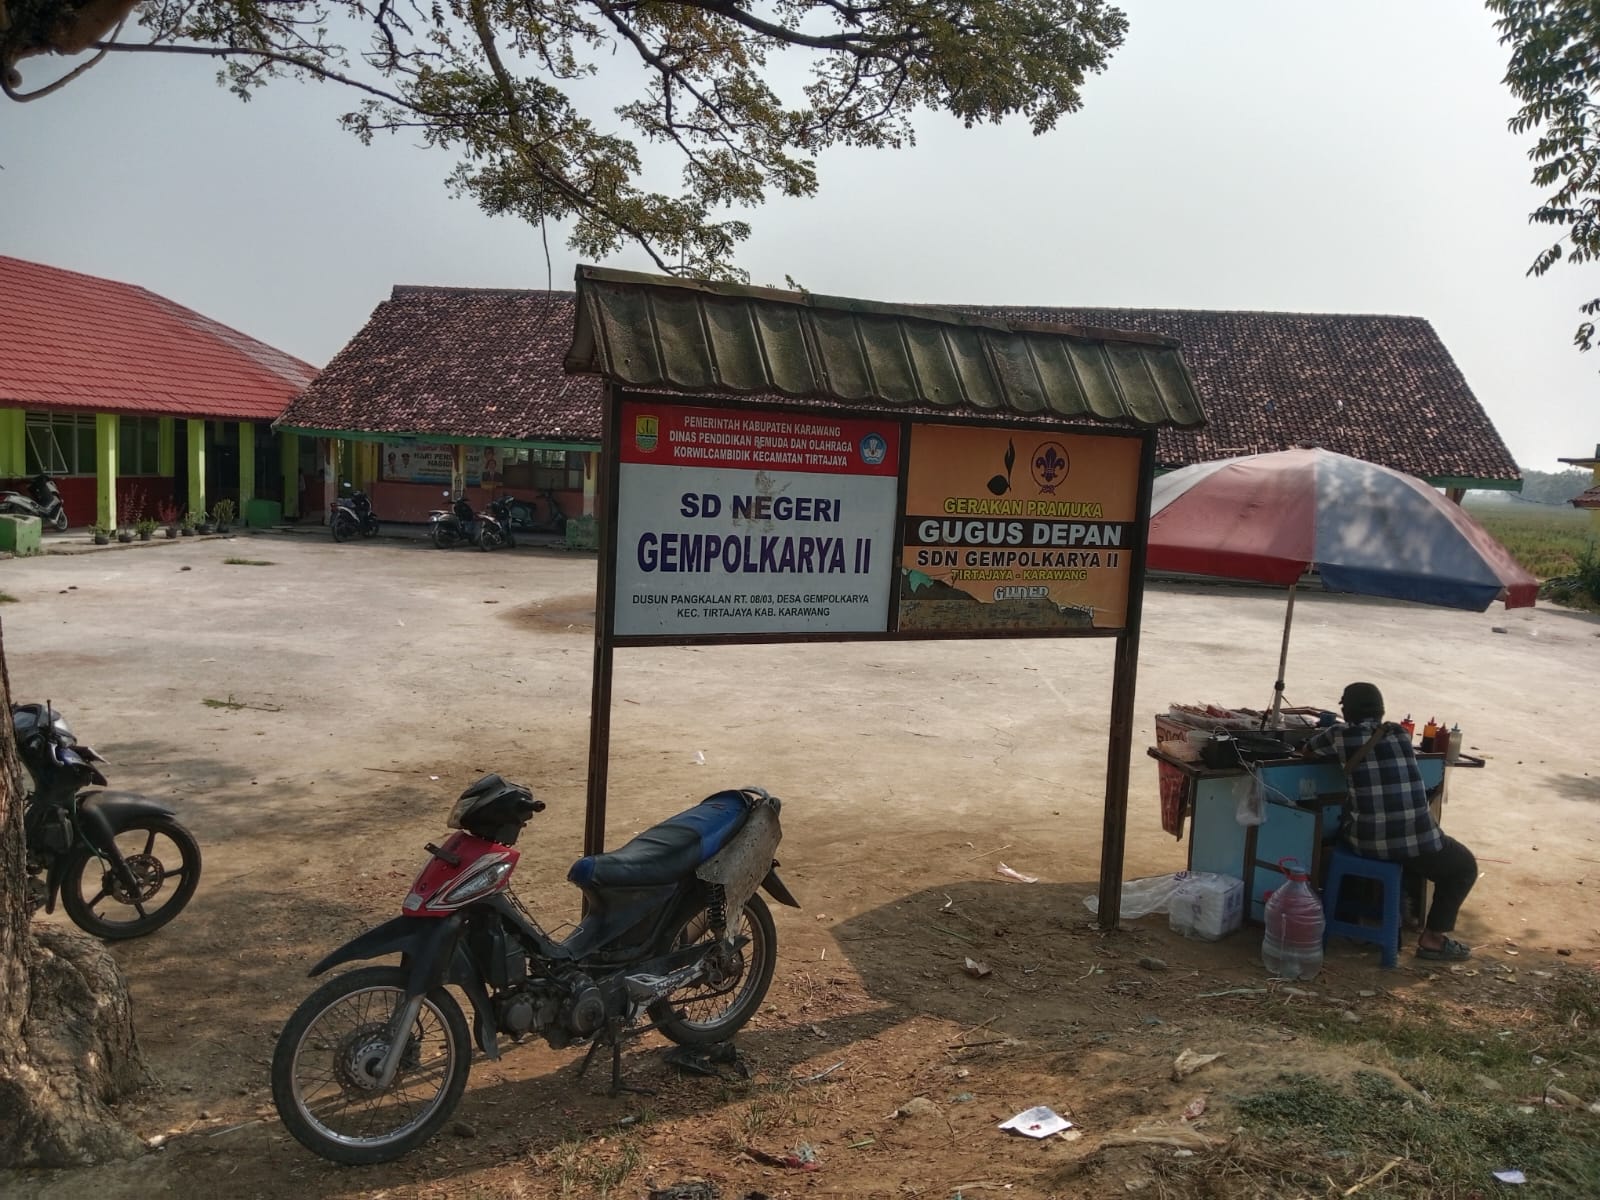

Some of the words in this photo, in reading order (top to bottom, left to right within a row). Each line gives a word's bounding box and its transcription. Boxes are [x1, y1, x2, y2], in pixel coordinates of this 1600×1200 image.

[684, 416, 740, 430] PEMERINTAH
[742, 419, 792, 434] KABUPATEN
[794, 422, 841, 437] KARAWANG
[669, 430, 697, 443] DINAS
[699, 432, 752, 446] PENDIDIKAN
[754, 436, 788, 448] PEMUDA
[790, 438, 807, 449] DAN
[809, 439, 853, 452] OLAHRAGA
[674, 446, 750, 461] KORWILCAMBIDIK
[752, 450, 803, 464] KECAMATAN
[805, 453, 848, 467] TIRTAJAYA
[680, 492, 721, 519] SD
[732, 495, 841, 522] NEGERI
[944, 497, 1023, 515] GERAKAN
[1027, 501, 1103, 518] PRAMUKA
[918, 520, 1024, 545] GUGUS
[1032, 523, 1122, 546] DEPAN
[637, 532, 846, 574] GEMPOLKARYA
[854, 538, 871, 574] II
[917, 550, 958, 567] SDN
[965, 550, 1101, 568] GEMPOLKARYA
[1107, 553, 1118, 567] II
[951, 569, 1013, 580] TIRTAJAYA
[1023, 570, 1088, 581] KARAWANG
[632, 595, 668, 604] DUSUN
[671, 595, 731, 604] PANGKALAN
[734, 595, 747, 604] RT.
[750, 594, 775, 605] 08/03,
[777, 594, 802, 604] DESA
[803, 594, 869, 604] GEMPOLKARYA
[677, 608, 700, 618] KEC.
[703, 608, 752, 618] TIRTAJAYA
[754, 608, 776, 617] KAB.
[778, 607, 830, 617] KARAWANG
